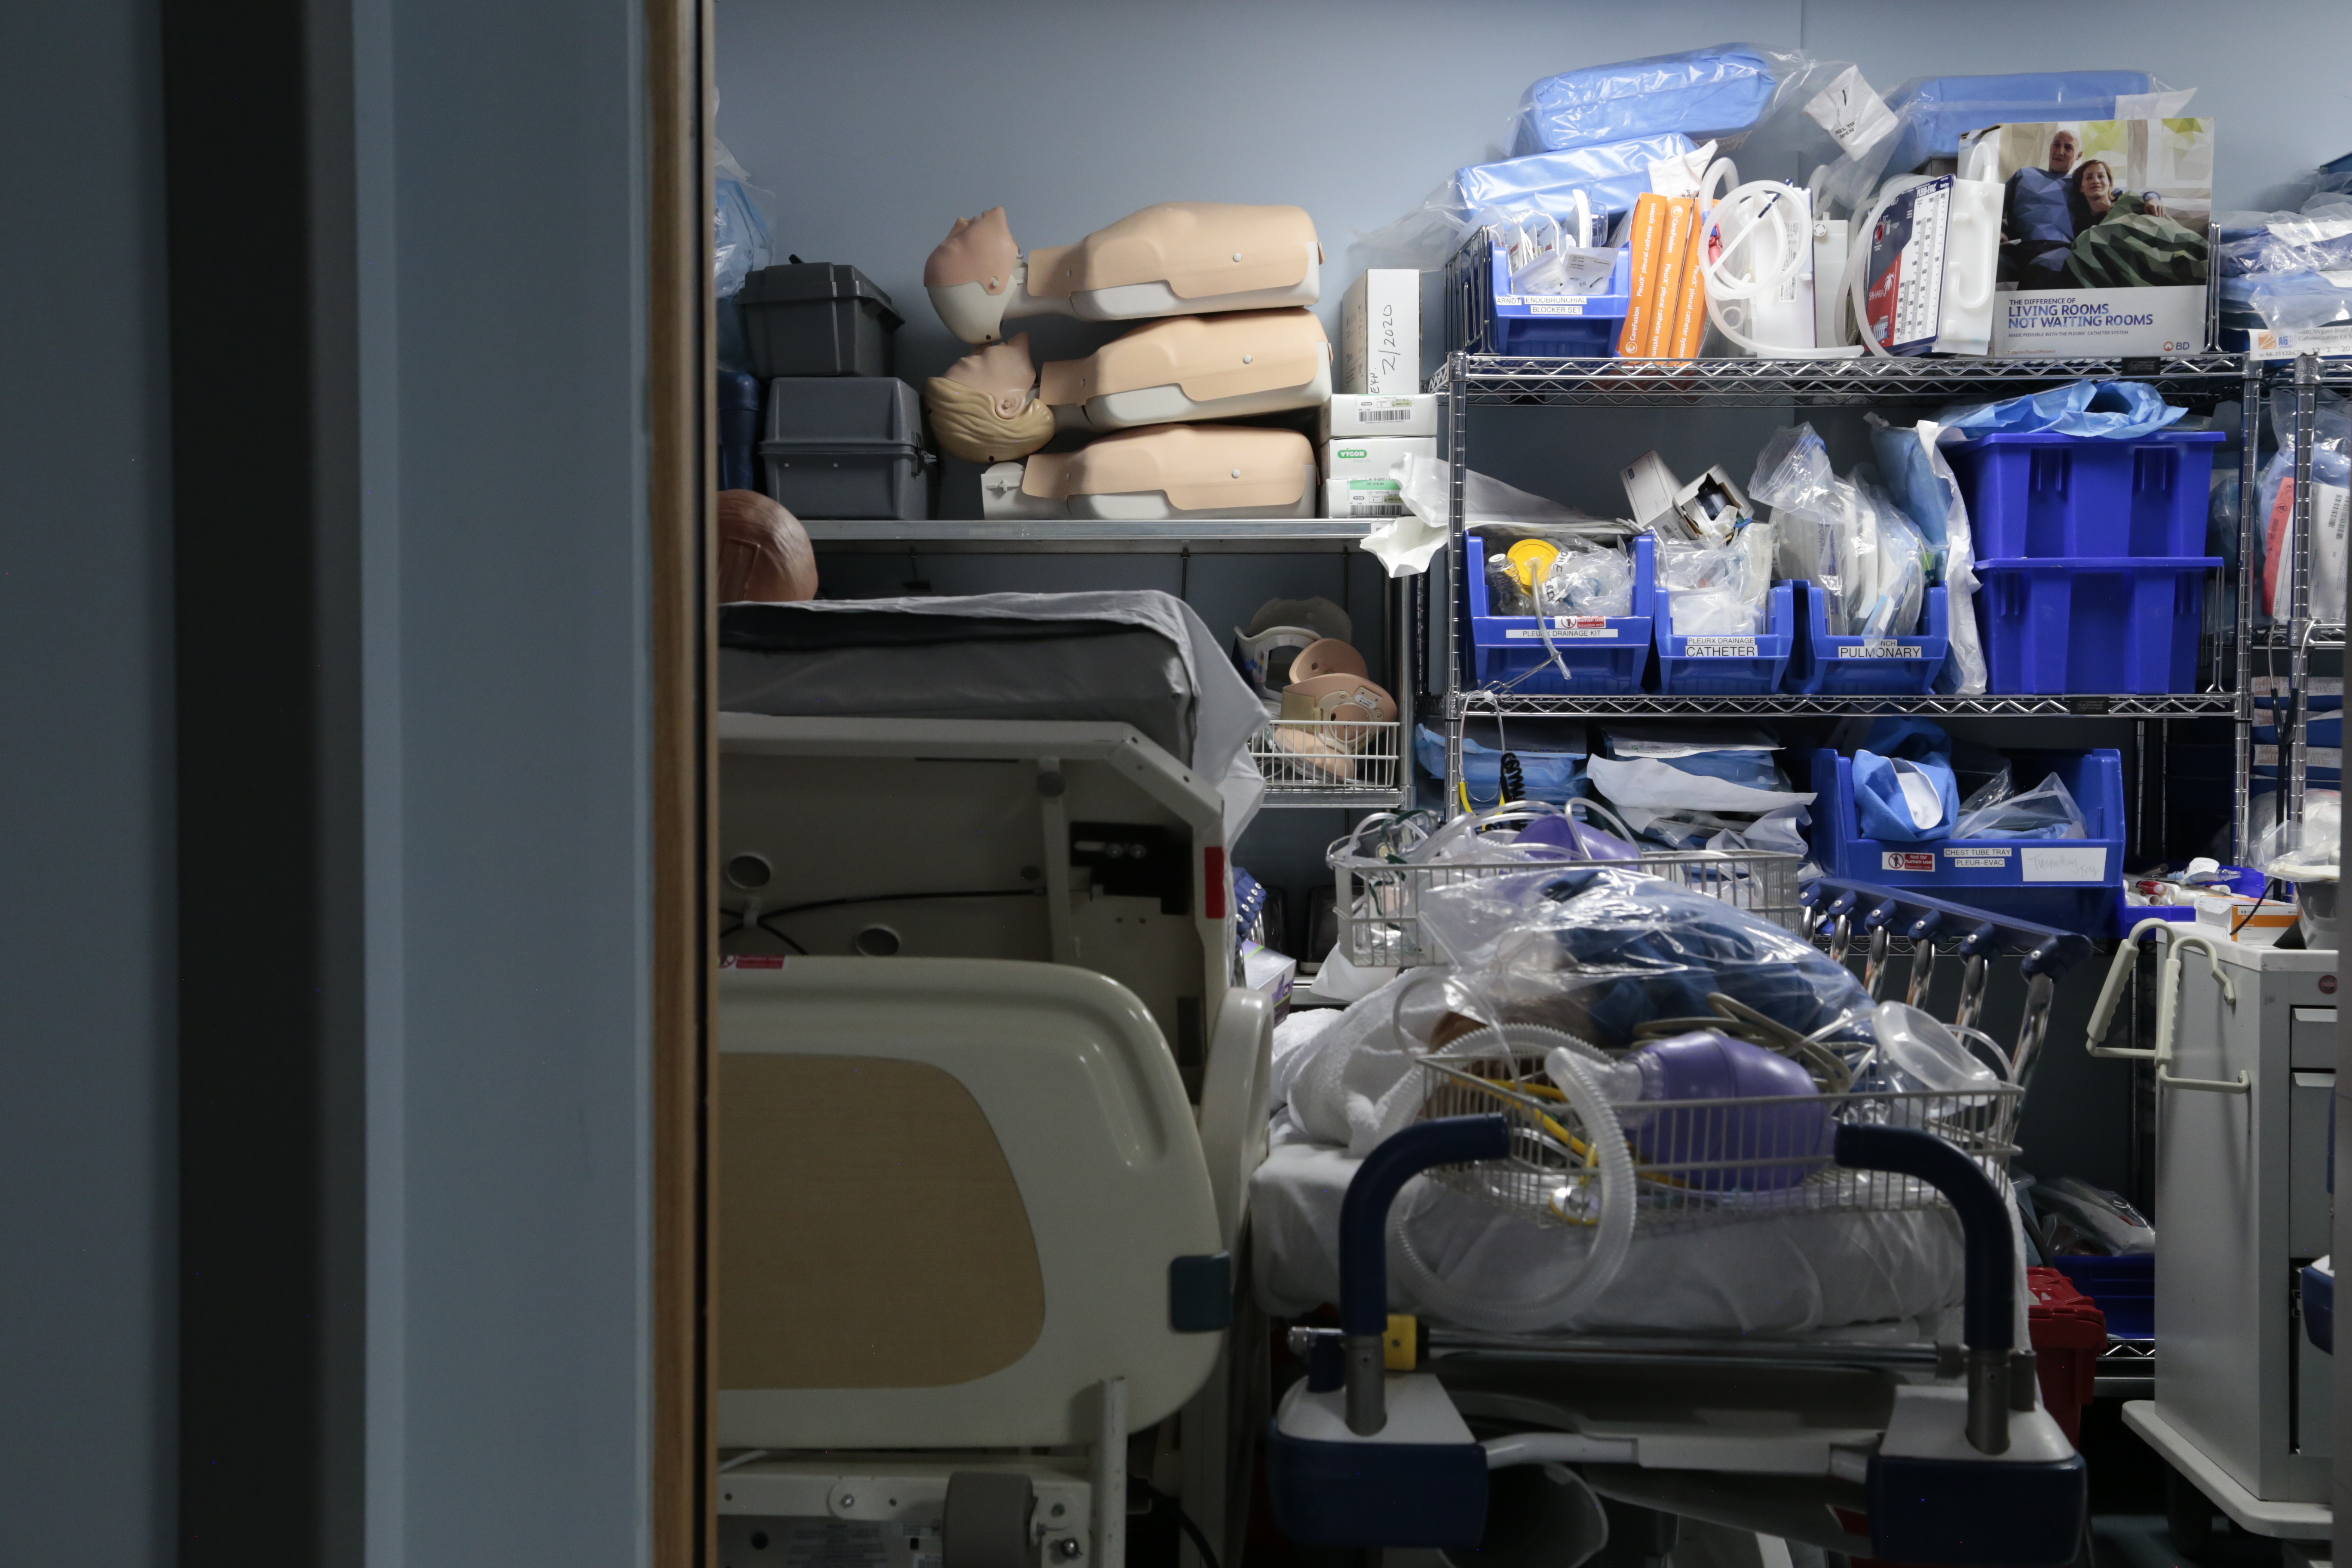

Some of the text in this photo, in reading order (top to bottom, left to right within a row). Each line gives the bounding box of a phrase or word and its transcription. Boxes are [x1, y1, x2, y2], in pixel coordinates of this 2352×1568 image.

[1835, 127, 1847, 135] PEEL
[1839, 128, 1855, 139] OPEN
[1644, 224, 1653, 251] catheter
[1667, 219, 1678, 253] CareFusion
[1640, 251, 1649, 274] pleural
[1658, 287, 1667, 308] pleural
[1687, 288, 1696, 310] pleural
[1868, 289, 1885, 301] SAHARA
[2008, 304, 2058, 317] LIVING
[1629, 307, 1640, 341] CareFusion
[1654, 309, 1663, 335] catheter
[1683, 311, 1691, 337] catheter
[2008, 314, 2153, 329] NOT WAITING ROOMS
[1378, 304, 1401, 375] 2/2020
[1651, 336, 1659, 356] system
[1678, 338, 1687, 358] system
[2176, 342, 2190, 350] BD
[1686, 646, 1755, 657] CATHETER
[1841, 647, 1920, 658] PULMONARY
[2079, 864, 2100, 878] Tray
